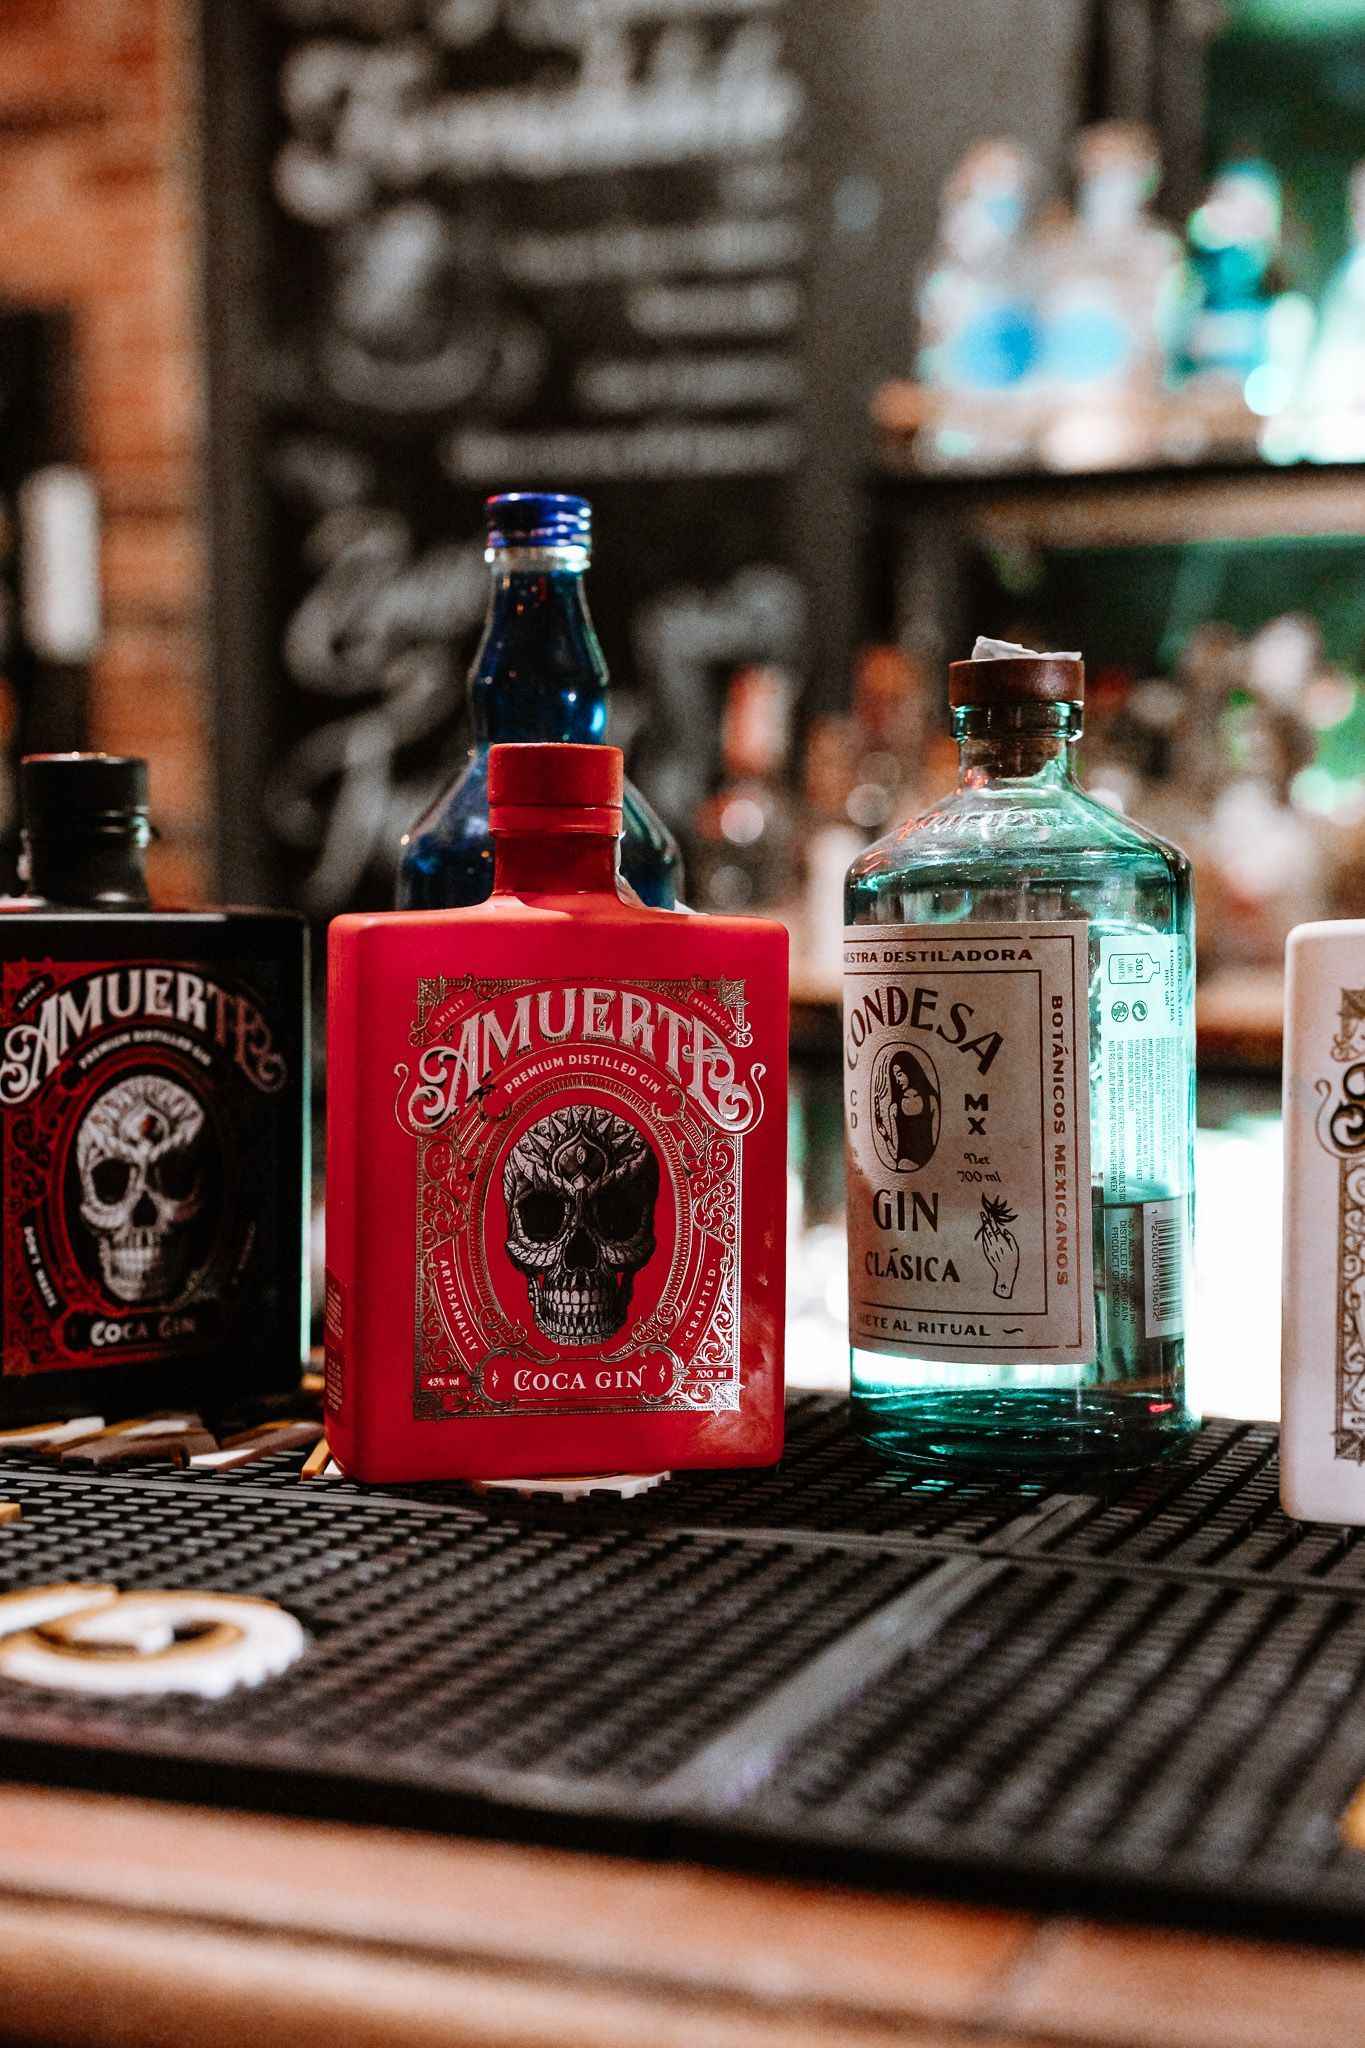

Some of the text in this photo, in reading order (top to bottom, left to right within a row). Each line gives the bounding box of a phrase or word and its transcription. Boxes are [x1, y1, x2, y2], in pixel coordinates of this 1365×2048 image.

[883, 949, 1033, 963] DESTILADORA
[1127, 963, 1134, 973] UK
[1135, 958, 1144, 979] 30.1
[434, 999, 466, 1028] SPIRIT
[693, 997, 731, 1030] BEVERAGE
[847, 985, 1005, 1077] CONDESA
[1117, 1052, 1124, 1061] UK
[503, 1054, 662, 1094] PREMIUM DISTILLED GIN
[964, 1093, 989, 1112] M
[967, 1117, 987, 1136] X
[1051, 995, 1069, 1286] BOTÁNICOS MEXICANOS
[963, 1152, 991, 1165] Net
[1110, 1164, 1118, 1175] PER
[957, 1170, 983, 1183] 700
[872, 1188, 939, 1233] GIN
[1127, 1218, 1135, 1236] 43%
[1151, 1225, 1159, 1269] 240000
[865, 1247, 961, 1283] CLÁSICA
[1111, 1227, 1121, 1318] PRODUCT OF MEXICO
[1119, 1220, 1129, 1321] DISTILLED FROM GRAIN
[1128, 1260, 1136, 1272] BY
[439, 1259, 479, 1352] ARTISANALLY
[685, 1268, 716, 1339] CRAFTED
[893, 1320, 912, 1332] AL
[918, 1321, 991, 1337] RITUAL
[427, 1377, 445, 1387] 43%
[513, 1365, 647, 1391] COCA GIN
